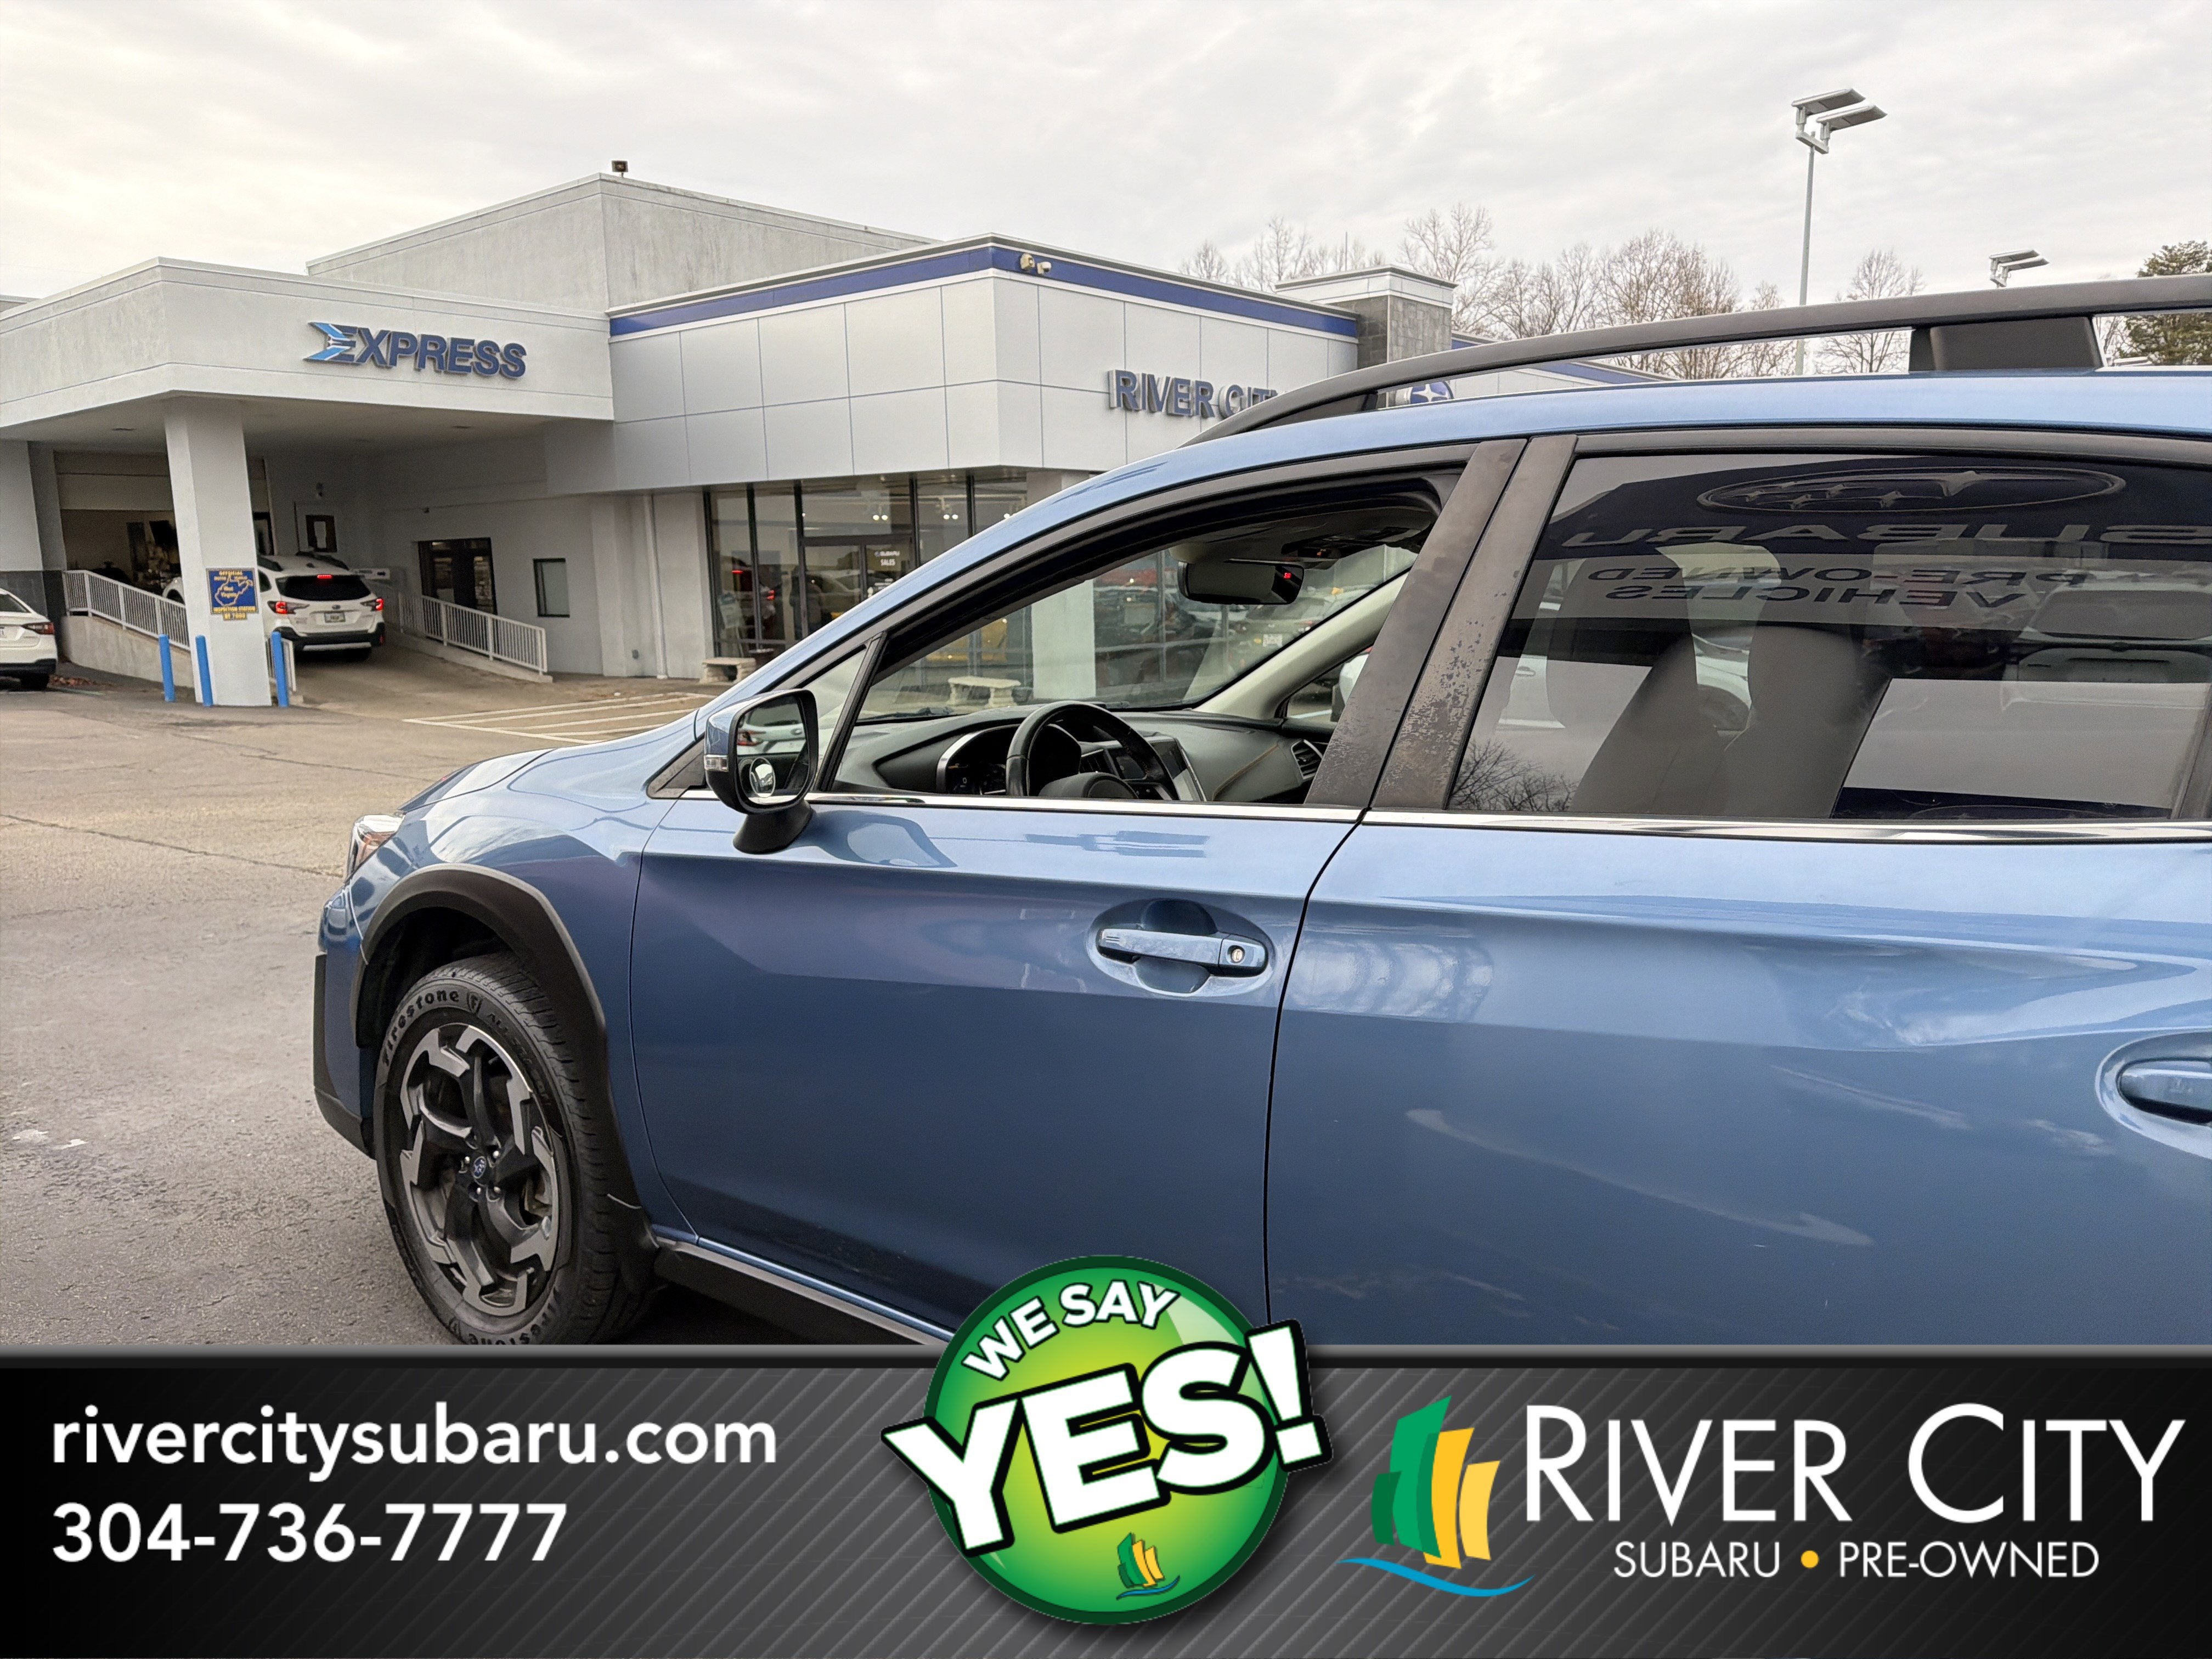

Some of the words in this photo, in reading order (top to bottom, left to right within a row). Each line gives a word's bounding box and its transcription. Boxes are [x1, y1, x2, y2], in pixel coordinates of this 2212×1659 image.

[303, 321, 527, 380] EXPRESS
[1108, 369, 1215, 419] RIVER
[382, 989, 460, 1067] Firestone
